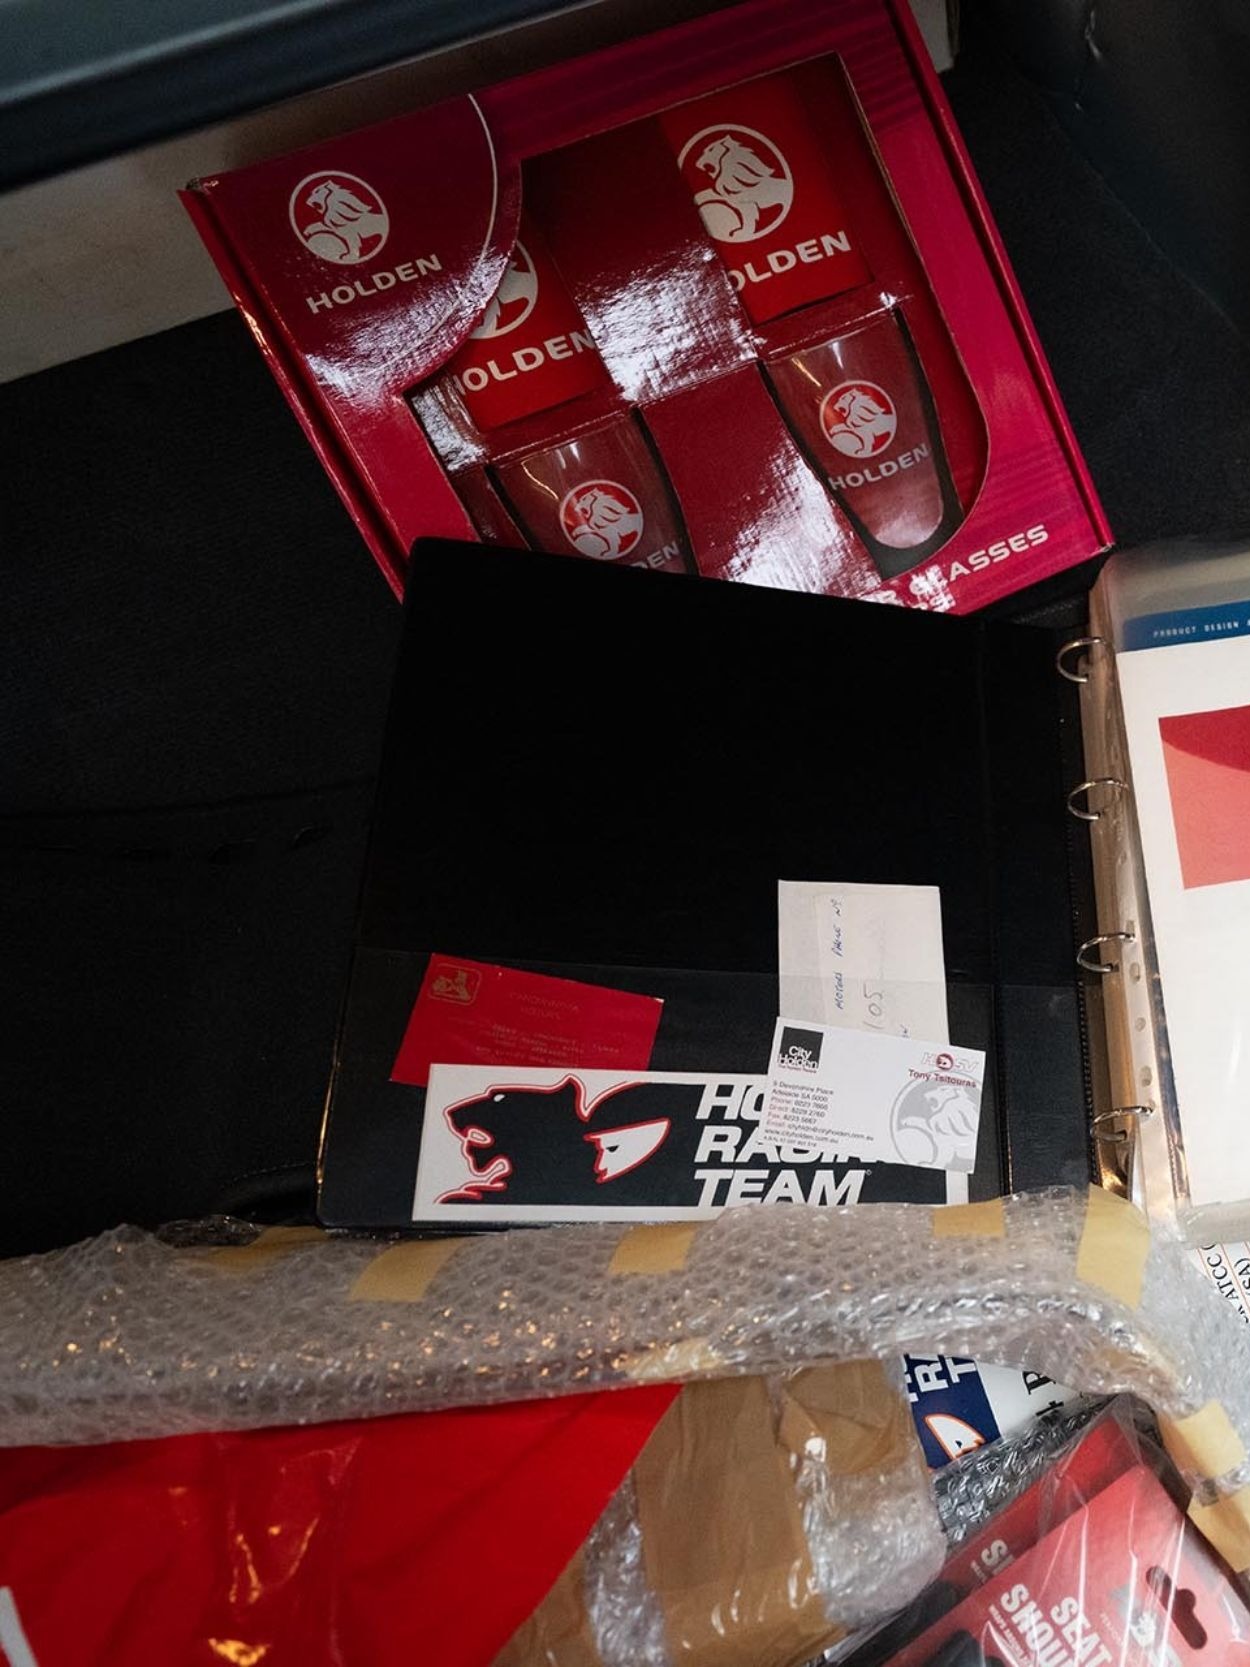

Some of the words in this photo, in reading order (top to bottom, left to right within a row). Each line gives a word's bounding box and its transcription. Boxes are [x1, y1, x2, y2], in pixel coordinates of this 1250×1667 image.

[305, 254, 442, 314] HOLDEN
[727, 230, 851, 291] OLDEN
[828, 443, 929, 490] HOLDEN
[1153, 625, 1197, 638] PRODUCT
[1204, 620, 1239, 632] DESIGN
[789, 1046, 812, 1060] City
[908, 1068, 931, 1082] Tony
[934, 1072, 977, 1089] Tsitouras
[694, 1169, 867, 1207] TEAM
[1000, 1584, 1077, 1667] SHOU
[1050, 1597, 1113, 1667] SEAT
